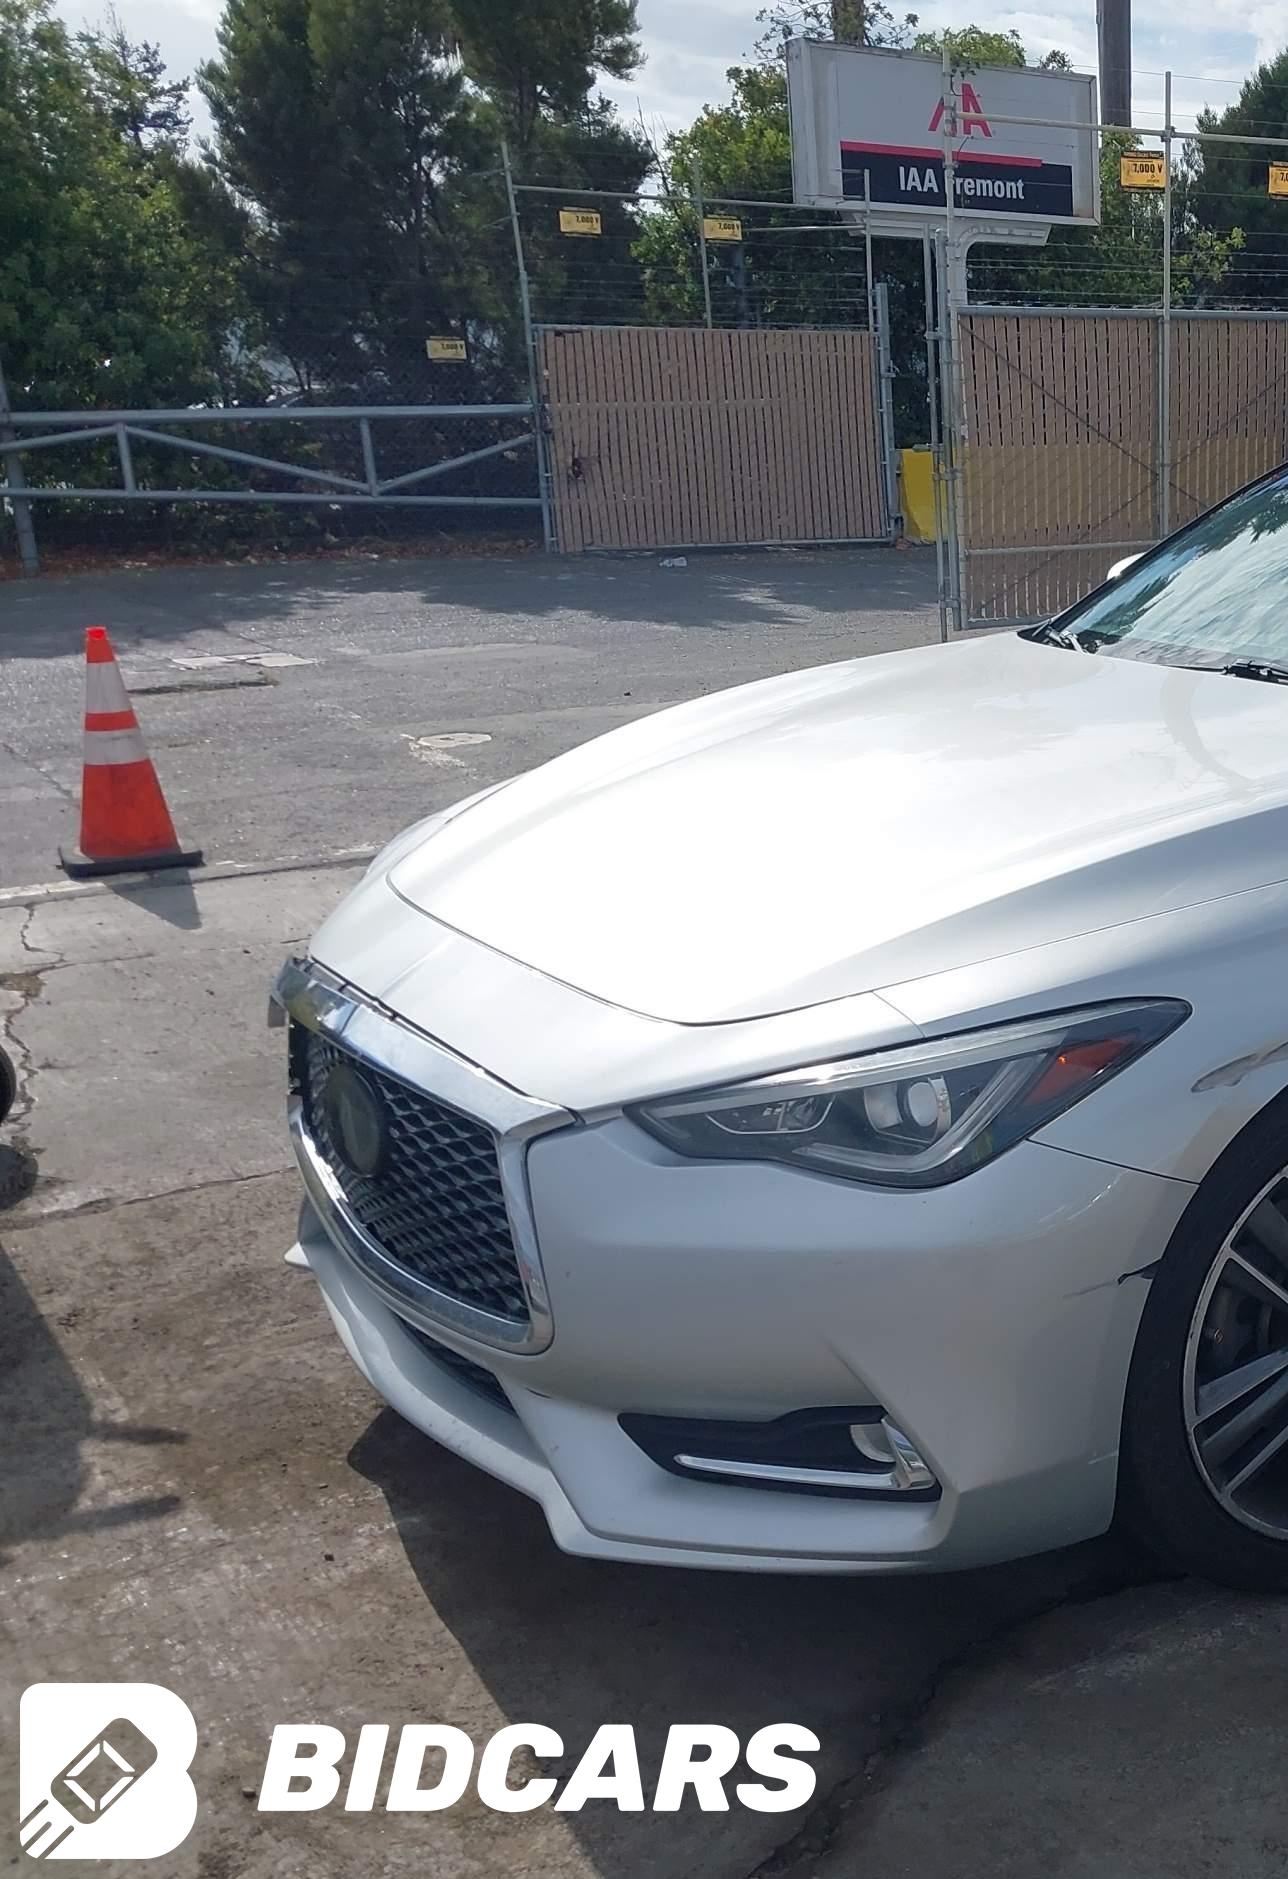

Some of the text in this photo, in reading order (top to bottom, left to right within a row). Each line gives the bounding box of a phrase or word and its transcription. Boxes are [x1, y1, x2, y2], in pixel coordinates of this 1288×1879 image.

[1132, 163, 1163, 174] 7,000 V
[899, 166, 939, 193] IAA
